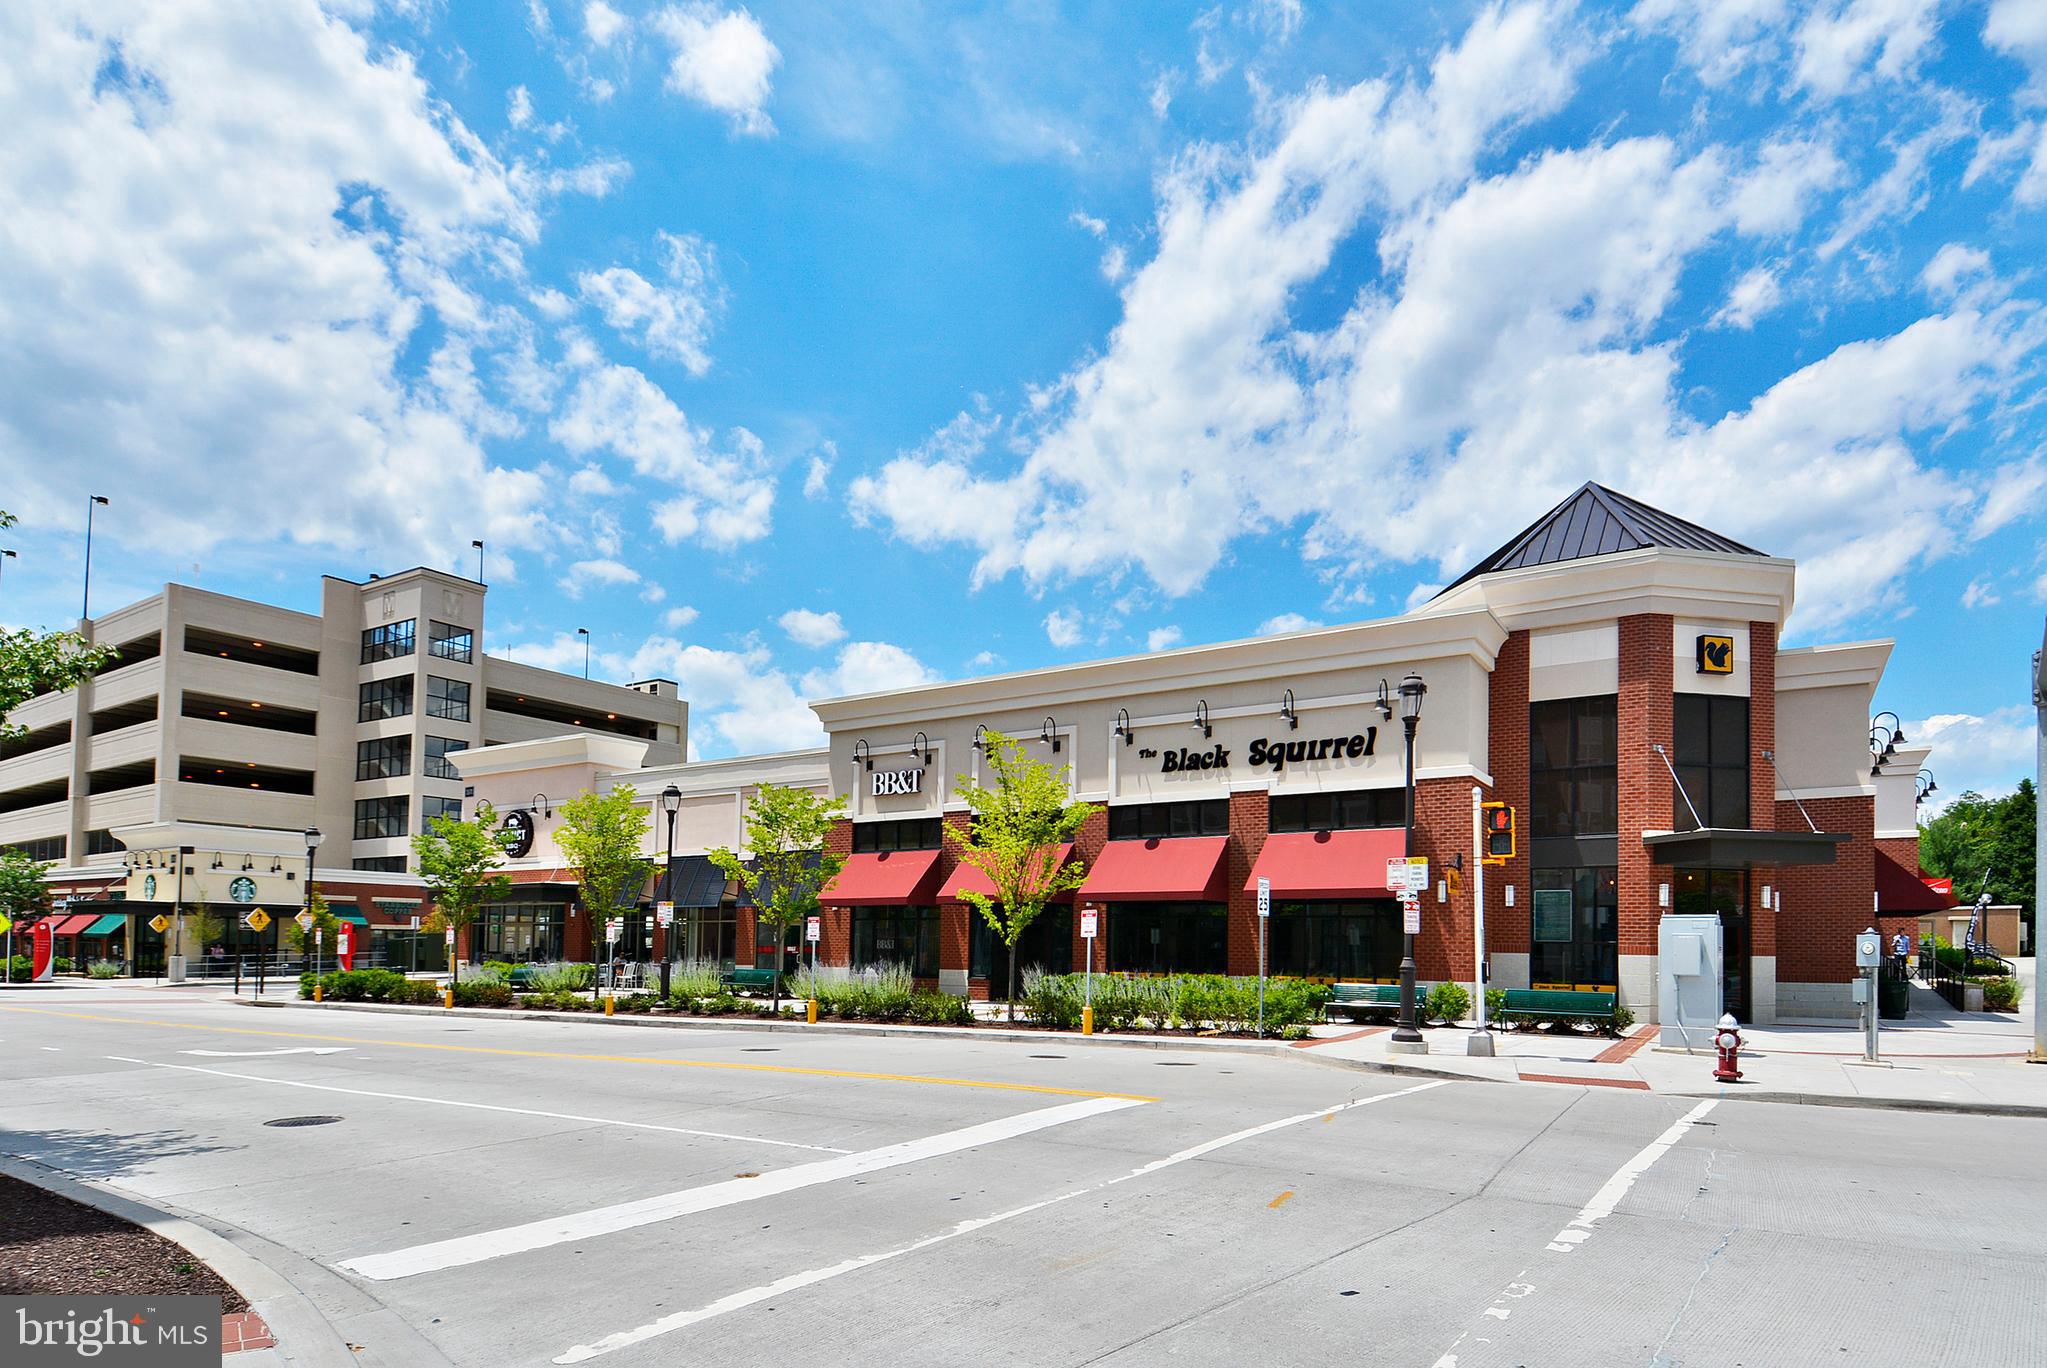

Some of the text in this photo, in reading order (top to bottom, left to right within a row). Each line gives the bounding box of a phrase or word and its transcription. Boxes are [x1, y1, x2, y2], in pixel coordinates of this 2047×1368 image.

[1139, 726, 1378, 773] The Black Squirrel
[872, 769, 924, 797] BB&T
[1259, 897, 1268, 911] 25
